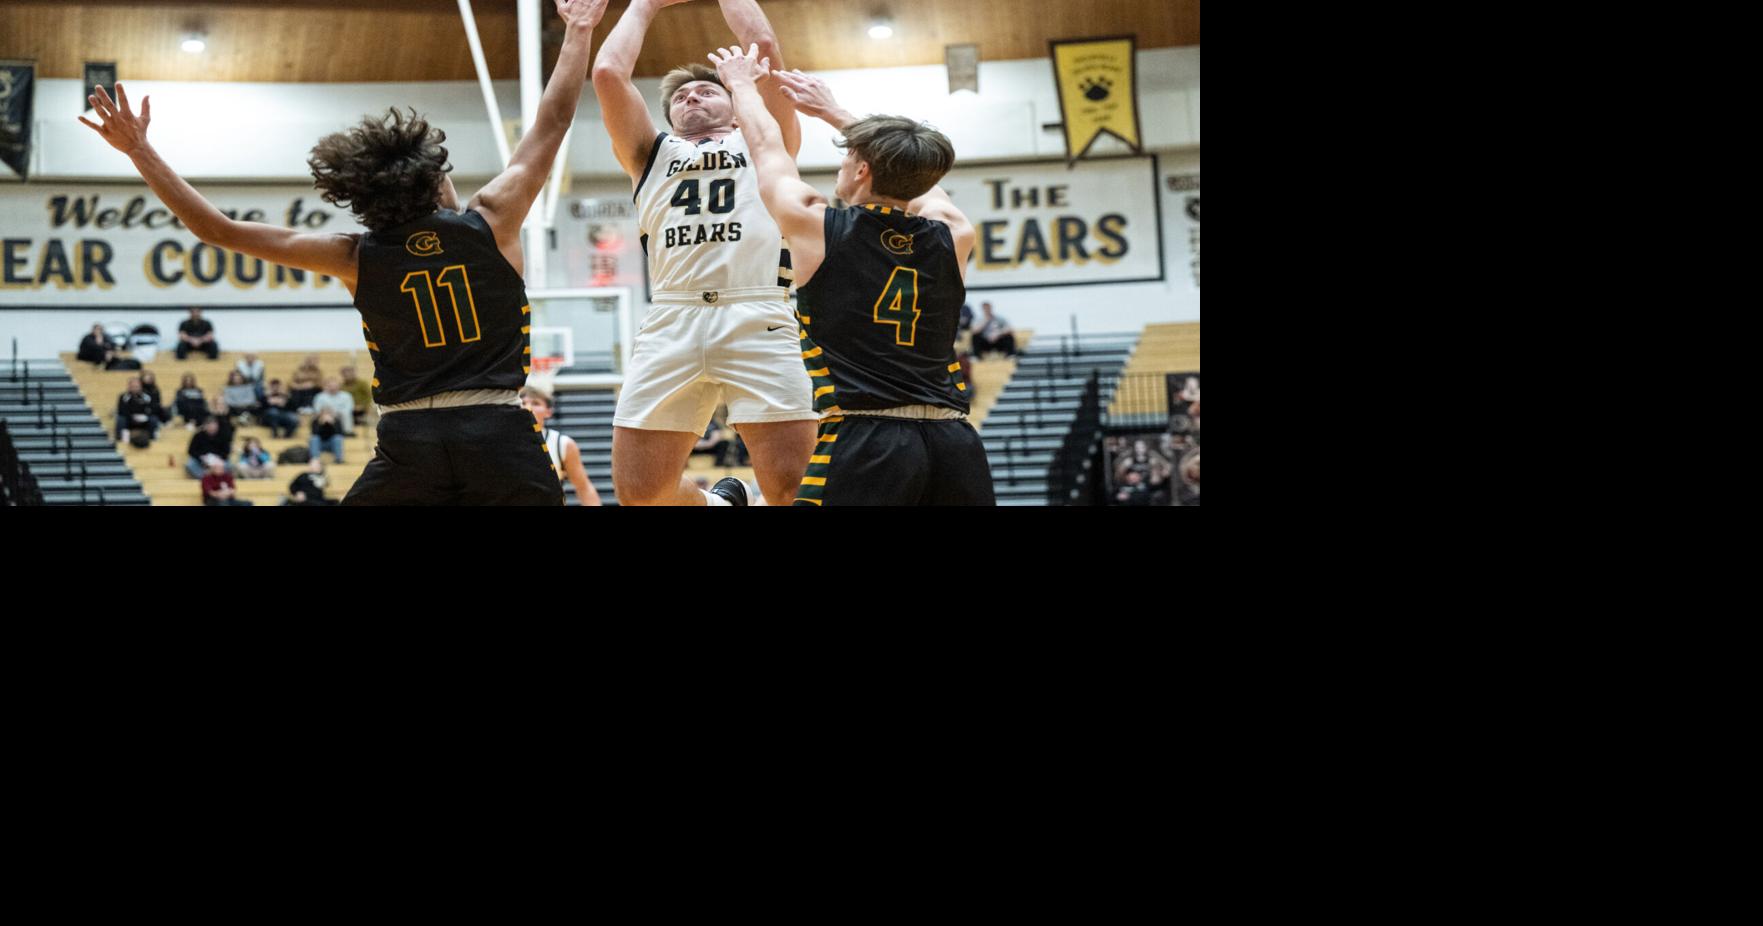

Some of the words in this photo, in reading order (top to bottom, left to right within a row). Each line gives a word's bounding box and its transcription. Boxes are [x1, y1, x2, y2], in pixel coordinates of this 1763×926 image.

[285, 198, 333, 228] to
[670, 178, 735, 216] 40
[664, 222, 742, 248] BEARS
[967, 212, 1129, 271] EARS
[400, 264, 481, 348] 11
[873, 266, 921, 346] 4
